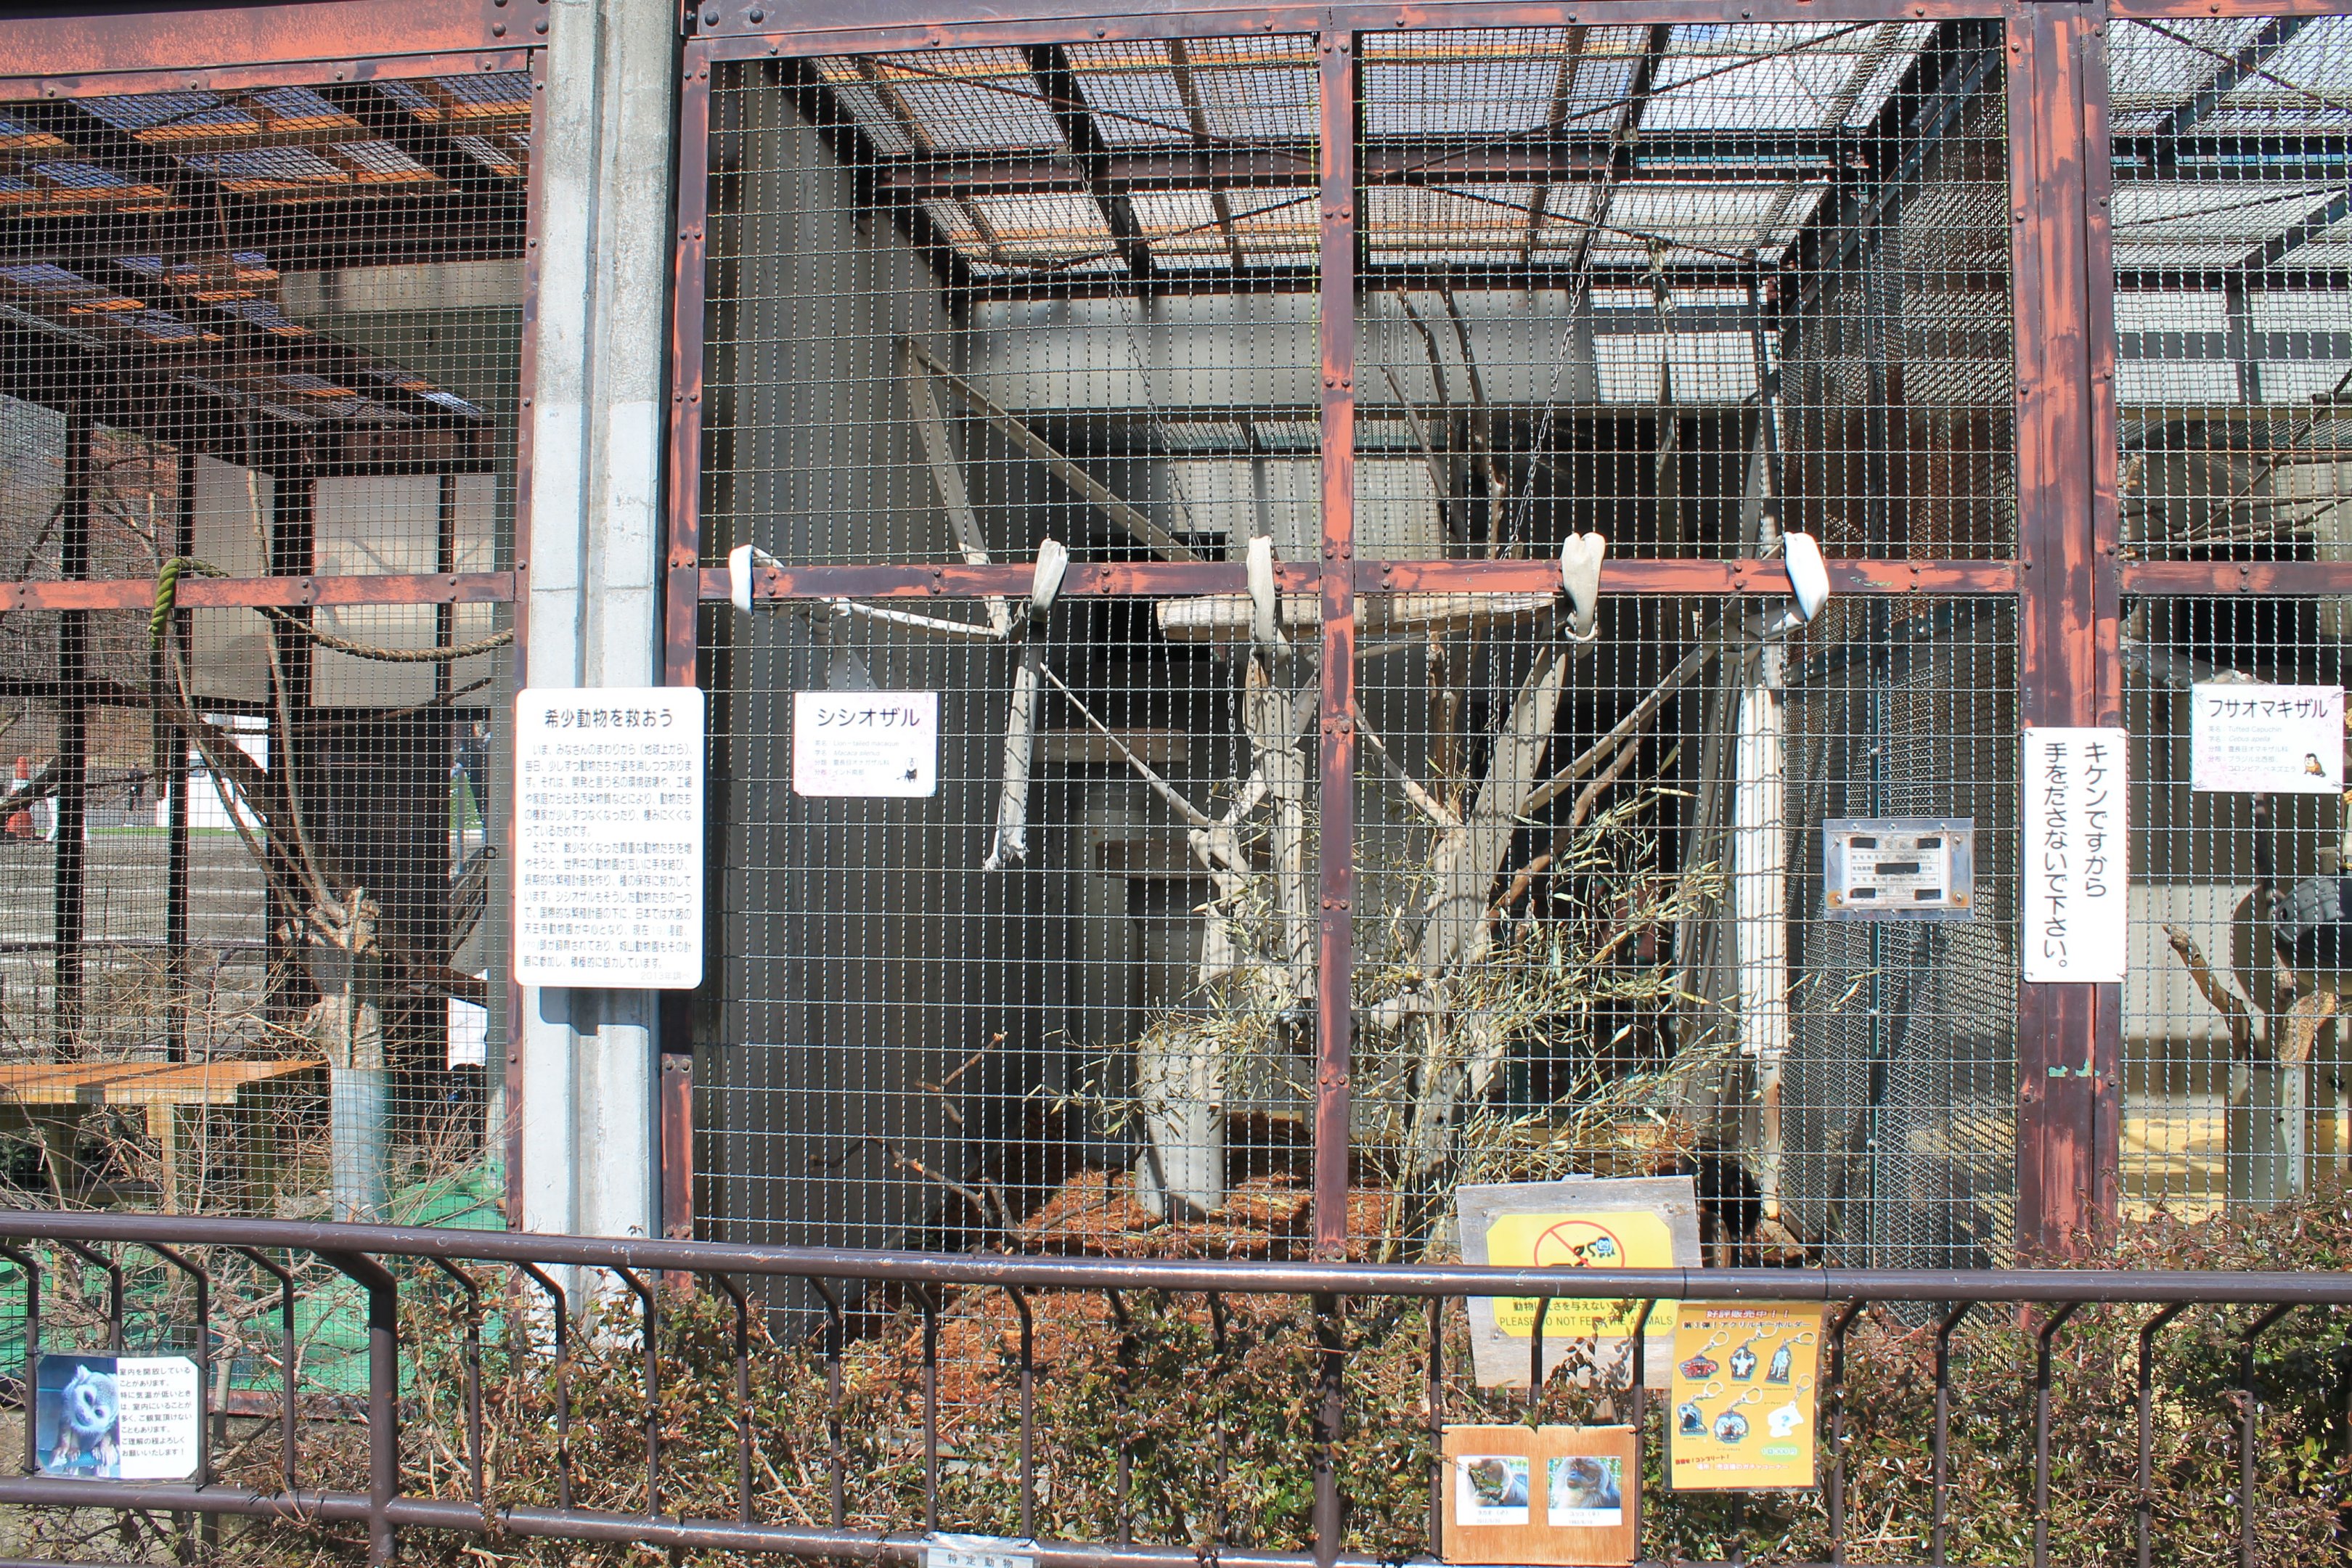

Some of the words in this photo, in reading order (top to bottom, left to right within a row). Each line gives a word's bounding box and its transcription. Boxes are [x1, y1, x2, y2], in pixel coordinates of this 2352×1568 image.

[2209, 698, 2328, 718] フサオマキザル
[544, 709, 673, 728] 希少動物を救おう
[817, 707, 920, 727] シシオザル
[525, 760, 692, 772] 毎日、少しずつ動物たちが姿を消しつつありま
[525, 793, 692, 804] や家庭から出る汚染物質などにより、動物たち
[2084, 741, 2108, 897] キケンですから
[525, 825, 592, 838] っているためです。
[532, 842, 692, 854] そこで、数少なくなった貴重な動物たちを増
[2043, 742, 2068, 968] 手をださないで下さい。
[525, 859, 688, 870] やそうと、世界中の動物園が互いに手を結び、
[524, 875, 691, 886] 長期的な繁殖計画を作り、種の保存に努力して
[524, 891, 692, 903] います。シシオザルもそうした動物たちの一つ
[524, 907, 691, 919] で、国際的な繁殖計画の下に、日本では大阪の
[524, 956, 662, 968] 画に参加し、積極的に協力しています。
[640, 971, 690, 981] 2013年調べ
[1556, 1317, 1575, 1326] NOT
[1630, 1316, 1673, 1325] AMALS
[947, 1553, 1013, 1568] 特定動物
